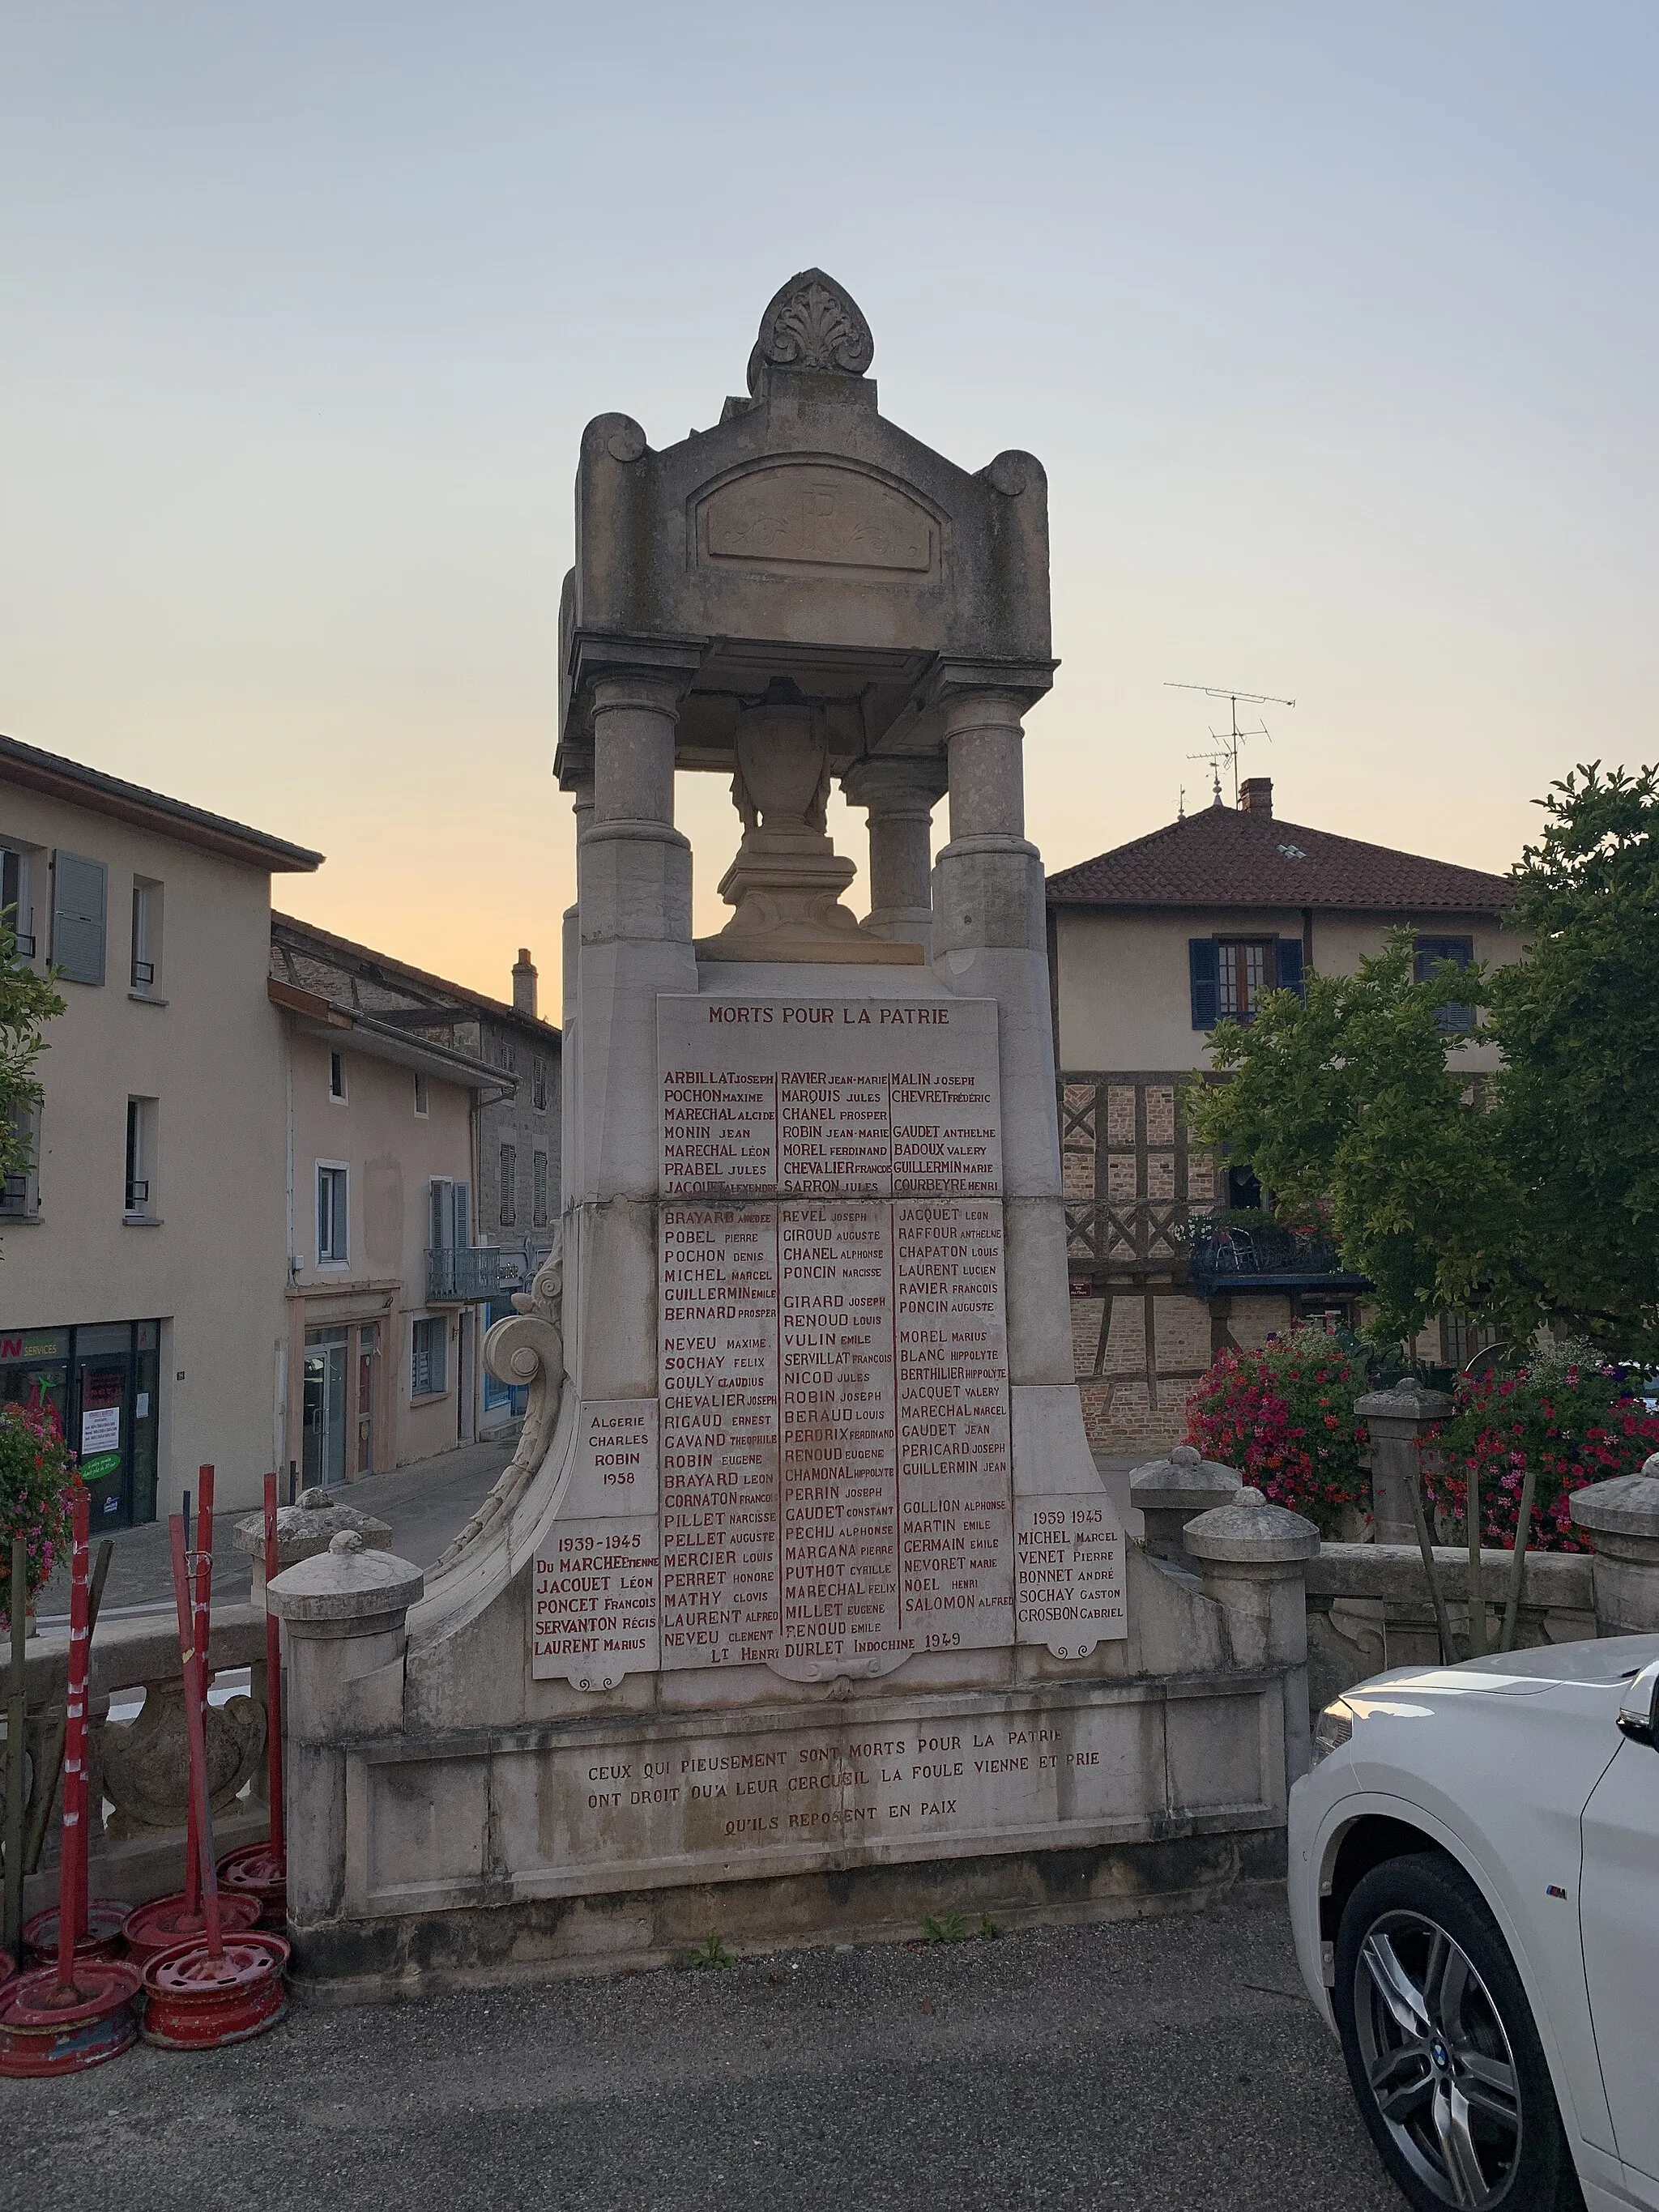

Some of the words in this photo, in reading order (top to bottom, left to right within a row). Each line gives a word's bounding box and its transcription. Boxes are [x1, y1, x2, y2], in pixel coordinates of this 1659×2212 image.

[710, 1007, 773, 1023] MORTS
[783, 1008, 834, 1023] POUR
[843, 1008, 871, 1024] LA
[881, 1009, 949, 1024] PATRIE
[663, 1072, 736, 1084] ARBILLAT
[734, 1075, 774, 1084] JOSEPH
[781, 1072, 826, 1085] RAVIER
[828, 1076, 887, 1085] JEAN-MARIE
[892, 1073, 931, 1085] MALIN
[934, 1076, 975, 1085] JOSEPH
[664, 1089, 721, 1102] POCHON
[723, 1093, 763, 1102] MAXIME
[782, 1089, 840, 1104] MARQUIS
[847, 1093, 881, 1102] JULES
[892, 1090, 949, 1102] CHEVRET
[665, 1108, 736, 1120] MARECHAL
[737, 1111, 774, 1120] ALCIDE
[783, 1108, 835, 1120] CHANEL
[840, 1111, 887, 1120] PROSPER
[664, 1127, 710, 1139] MONIN
[719, 1129, 750, 1138] JEAN
[783, 1126, 822, 1138] ROBIN
[826, 1129, 889, 1138] JEAN-MARIE
[893, 1125, 940, 1138] GAUDET
[665, 1144, 737, 1157] MARECHAL
[741, 1145, 770, 1157] LÉON
[783, 1144, 826, 1156] MOREL
[830, 1147, 887, 1156] FERDINAND
[894, 1144, 945, 1156] BADOUX
[947, 1147, 987, 1155] VALERY
[665, 1162, 723, 1175] PRABEL
[728, 1166, 766, 1174] JULES
[784, 1161, 855, 1174] CHEVALIER
[893, 1161, 962, 1173] GUILLERMIN
[963, 1164, 993, 1173] MARIE
[784, 1180, 840, 1193] SARRON
[842, 1183, 878, 1193] JULES
[893, 1178, 967, 1192] COURBEYRE
[968, 1182, 997, 1191] HENRI
[665, 1231, 715, 1243] POBEL
[725, 1234, 757, 1243] PIERRE
[783, 1229, 832, 1242] GIROUD
[836, 1231, 880, 1241] AUGUSTE
[665, 1250, 725, 1263] POCHON
[734, 1252, 763, 1264] DENIS
[784, 1247, 838, 1260] CHANEL
[841, 1250, 883, 1259] ALPHONSE
[899, 1246, 967, 1258] CHAPATON
[972, 1248, 998, 1256] LOUIS
[665, 1269, 726, 1282] MICHEL
[731, 1271, 772, 1281] MARCEL
[784, 1266, 835, 1279] PONCIN
[842, 1268, 881, 1277] NARCISSE
[898, 1262, 958, 1276] LAURENT
[963, 1266, 996, 1276] LUCIEN
[899, 1282, 948, 1295] RAVIER
[953, 1284, 997, 1296] FRANCOIS
[784, 1295, 843, 1308] GIRARD
[849, 1297, 885, 1306] JOSEPH
[665, 1306, 736, 1321] BERNARD
[738, 1309, 776, 1318] PROSPER
[784, 1314, 848, 1328] RENOUD
[853, 1316, 881, 1326] LOUIS
[901, 1330, 947, 1345] MOREL
[952, 1332, 987, 1342] MARIUS
[23, 1344, 57, 1356] SERVICES
[901, 1349, 945, 1362] BLANC
[951, 1350, 998, 1361] HIPPOLYTE
[665, 1356, 725, 1372] SOCHAY
[735, 1357, 764, 1368] FELIX
[785, 1371, 833, 1384] NICOD
[838, 1373, 870, 1383] JULES
[665, 1393, 745, 1409] CHEVALIER
[747, 1396, 777, 1405] JOSEPH
[591, 1417, 645, 1430] ALGERIE
[589, 1434, 648, 1447] CHARLES
[902, 1443, 969, 1457] PERICARD
[972, 1443, 1004, 1453] JOSEPH
[595, 1453, 639, 1466] ROBIN
[603, 1473, 634, 1485] 1958
[786, 1505, 844, 1521] GAUDET
[847, 1507, 893, 1517] CONSTANT
[1034, 1511, 1064, 1525] 1939
[1073, 1509, 1102, 1524] 1945
[904, 1519, 955, 1533] MARTIN
[964, 1520, 991, 1530] EMILE
[559, 1534, 641, 1552] 1939-1945
[664, 1532, 726, 1547] PELLET
[730, 1532, 774, 1544] AUGUSTE
[1017, 1528, 1071, 1545] MICHEL
[786, 1544, 856, 1560] MARGANA
[861, 1545, 893, 1555] PIERRE
[1018, 1549, 1065, 1564] VENET
[664, 1571, 727, 1588] PERRET
[733, 1571, 774, 1583] HONORE
[786, 1564, 845, 1582] PUTHOT
[851, 1565, 891, 1577] CYRILLE
[1019, 1569, 1073, 1586] BONNET
[664, 1591, 721, 1608] MATHY
[734, 1592, 768, 1603] CLOVIS
[1020, 1588, 1074, 1603] SOCHAY
[538, 1597, 599, 1617] PONCET
[1018, 1606, 1077, 1622] GROSBON
[535, 1616, 616, 1634] SERVANTON
[535, 1638, 599, 1658] LAURENT
[785, 1640, 843, 1660] DURLET
[925, 1633, 960, 1647] 1949
[589, 1765, 633, 1783] CEUX
[644, 1762, 669, 1779] QUI
[681, 1750, 787, 1773] PIEUSEMENT
[800, 1747, 840, 1762] SONT
[849, 1741, 905, 1758] MORTS
[916, 1734, 961, 1754] POUR
[973, 1735, 994, 1747] LA
[1009, 1730, 1061, 1747] PATRIE
[588, 1791, 621, 1809] ONT
[631, 1788, 680, 1805] DROIT
[736, 1779, 778, 1796] LEUR
[787, 1768, 869, 1794] CERCUEIL
[881, 1769, 902, 1782] LA
[912, 1762, 963, 1779] FOULE
[974, 1758, 1028, 1773] VIENNE
[1039, 1755, 1058, 1768] ET
[1066, 1753, 1099, 1765] PRIE
[789, 1805, 877, 1827] REPOSENT
[889, 1805, 910, 1818] EN
[921, 1800, 957, 1815] PAIX
